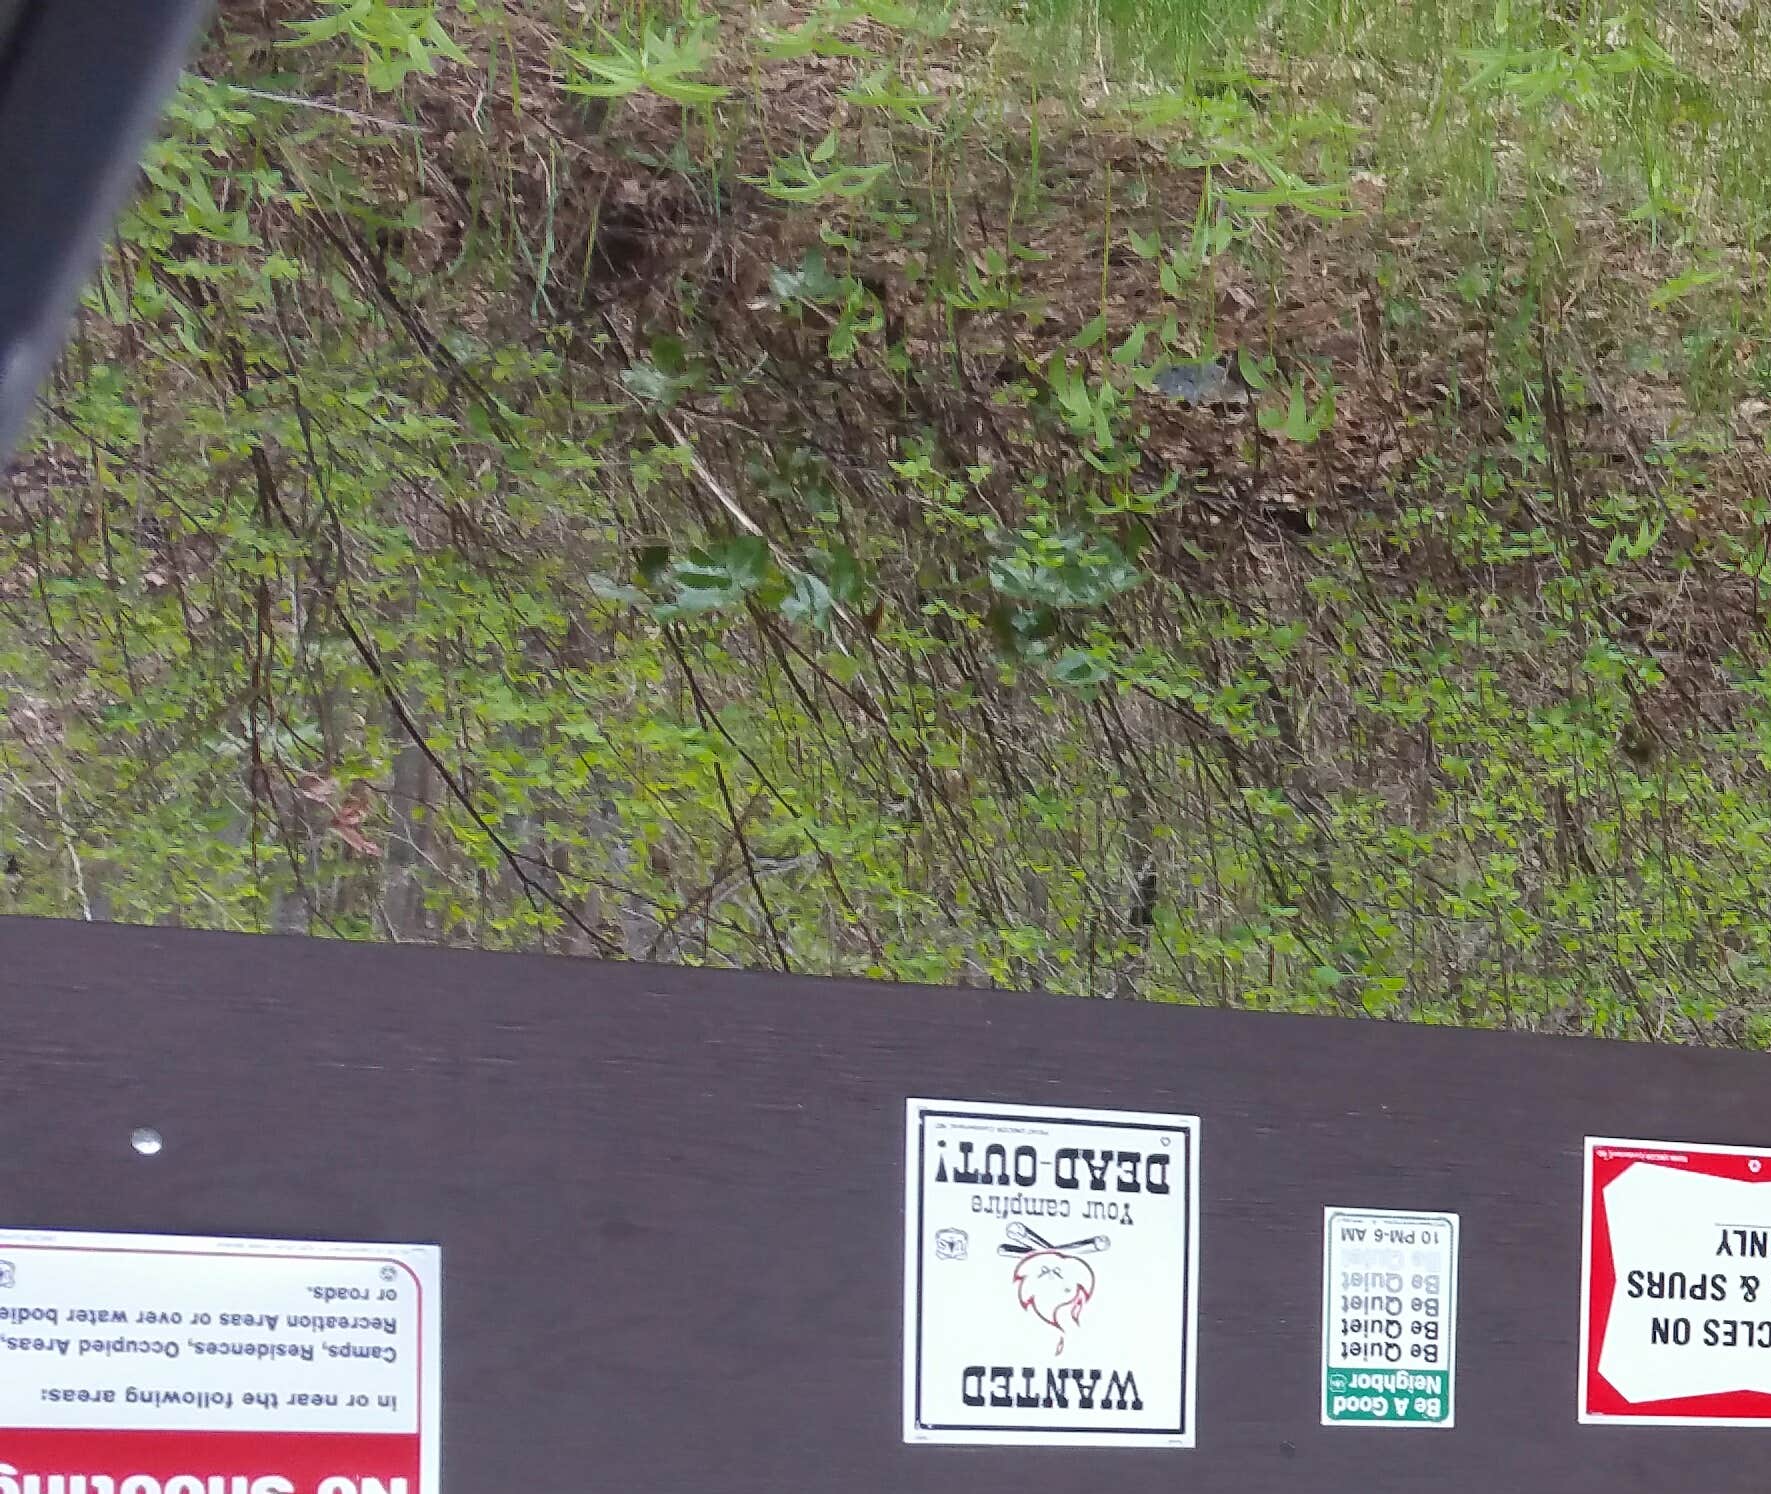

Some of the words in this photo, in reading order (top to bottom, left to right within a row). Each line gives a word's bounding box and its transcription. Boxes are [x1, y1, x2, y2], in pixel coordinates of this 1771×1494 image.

[971, 1193, 1071, 1219] campfire
[1082, 1201, 1133, 1226] Your
[1341, 1228, 1367, 1242] AM
[1421, 1231, 1439, 1244] 10
[1341, 1272, 1403, 1293] Quiet
[1411, 1275, 1440, 1294] Be
[1627, 1270, 1727, 1301] SPURS
[1740, 1275, 1760, 1302] &
[307, 1286, 369, 1303] roads.
[377, 1288, 397, 1302] or
[1341, 1296, 1402, 1316] Quiet
[1411, 1298, 1439, 1317] Be
[68, 1309, 127, 1327] water
[136, 1309, 182, 1326] over
[191, 1311, 211, 1326] or
[219, 1312, 279, 1330] Areas
[286, 1313, 397, 1334] Recreation
[1341, 1319, 1402, 1339] Quiet
[1410, 1321, 1438, 1340] Be
[1651, 1317, 1691, 1345] ON
[0, 1335, 70, 1355] Areas,
[79, 1336, 180, 1358] Occupied
[187, 1339, 314, 1361] Residences,
[322, 1341, 397, 1363] Camps,
[1341, 1342, 1402, 1363] Quiet
[1410, 1343, 1438, 1363] Be
[962, 1366, 1144, 1411] WANTED
[1349, 1370, 1442, 1394] Neighbor
[40, 1388, 116, 1404] areas:
[125, 1386, 233, 1409] following
[242, 1391, 278, 1410] the
[287, 1392, 338, 1408] near
[347, 1393, 369, 1408] or
[378, 1394, 397, 1411] in
[1333, 1396, 1389, 1416] Good
[1394, 1397, 1409, 1416] A
[1414, 1397, 1442, 1417] Be
